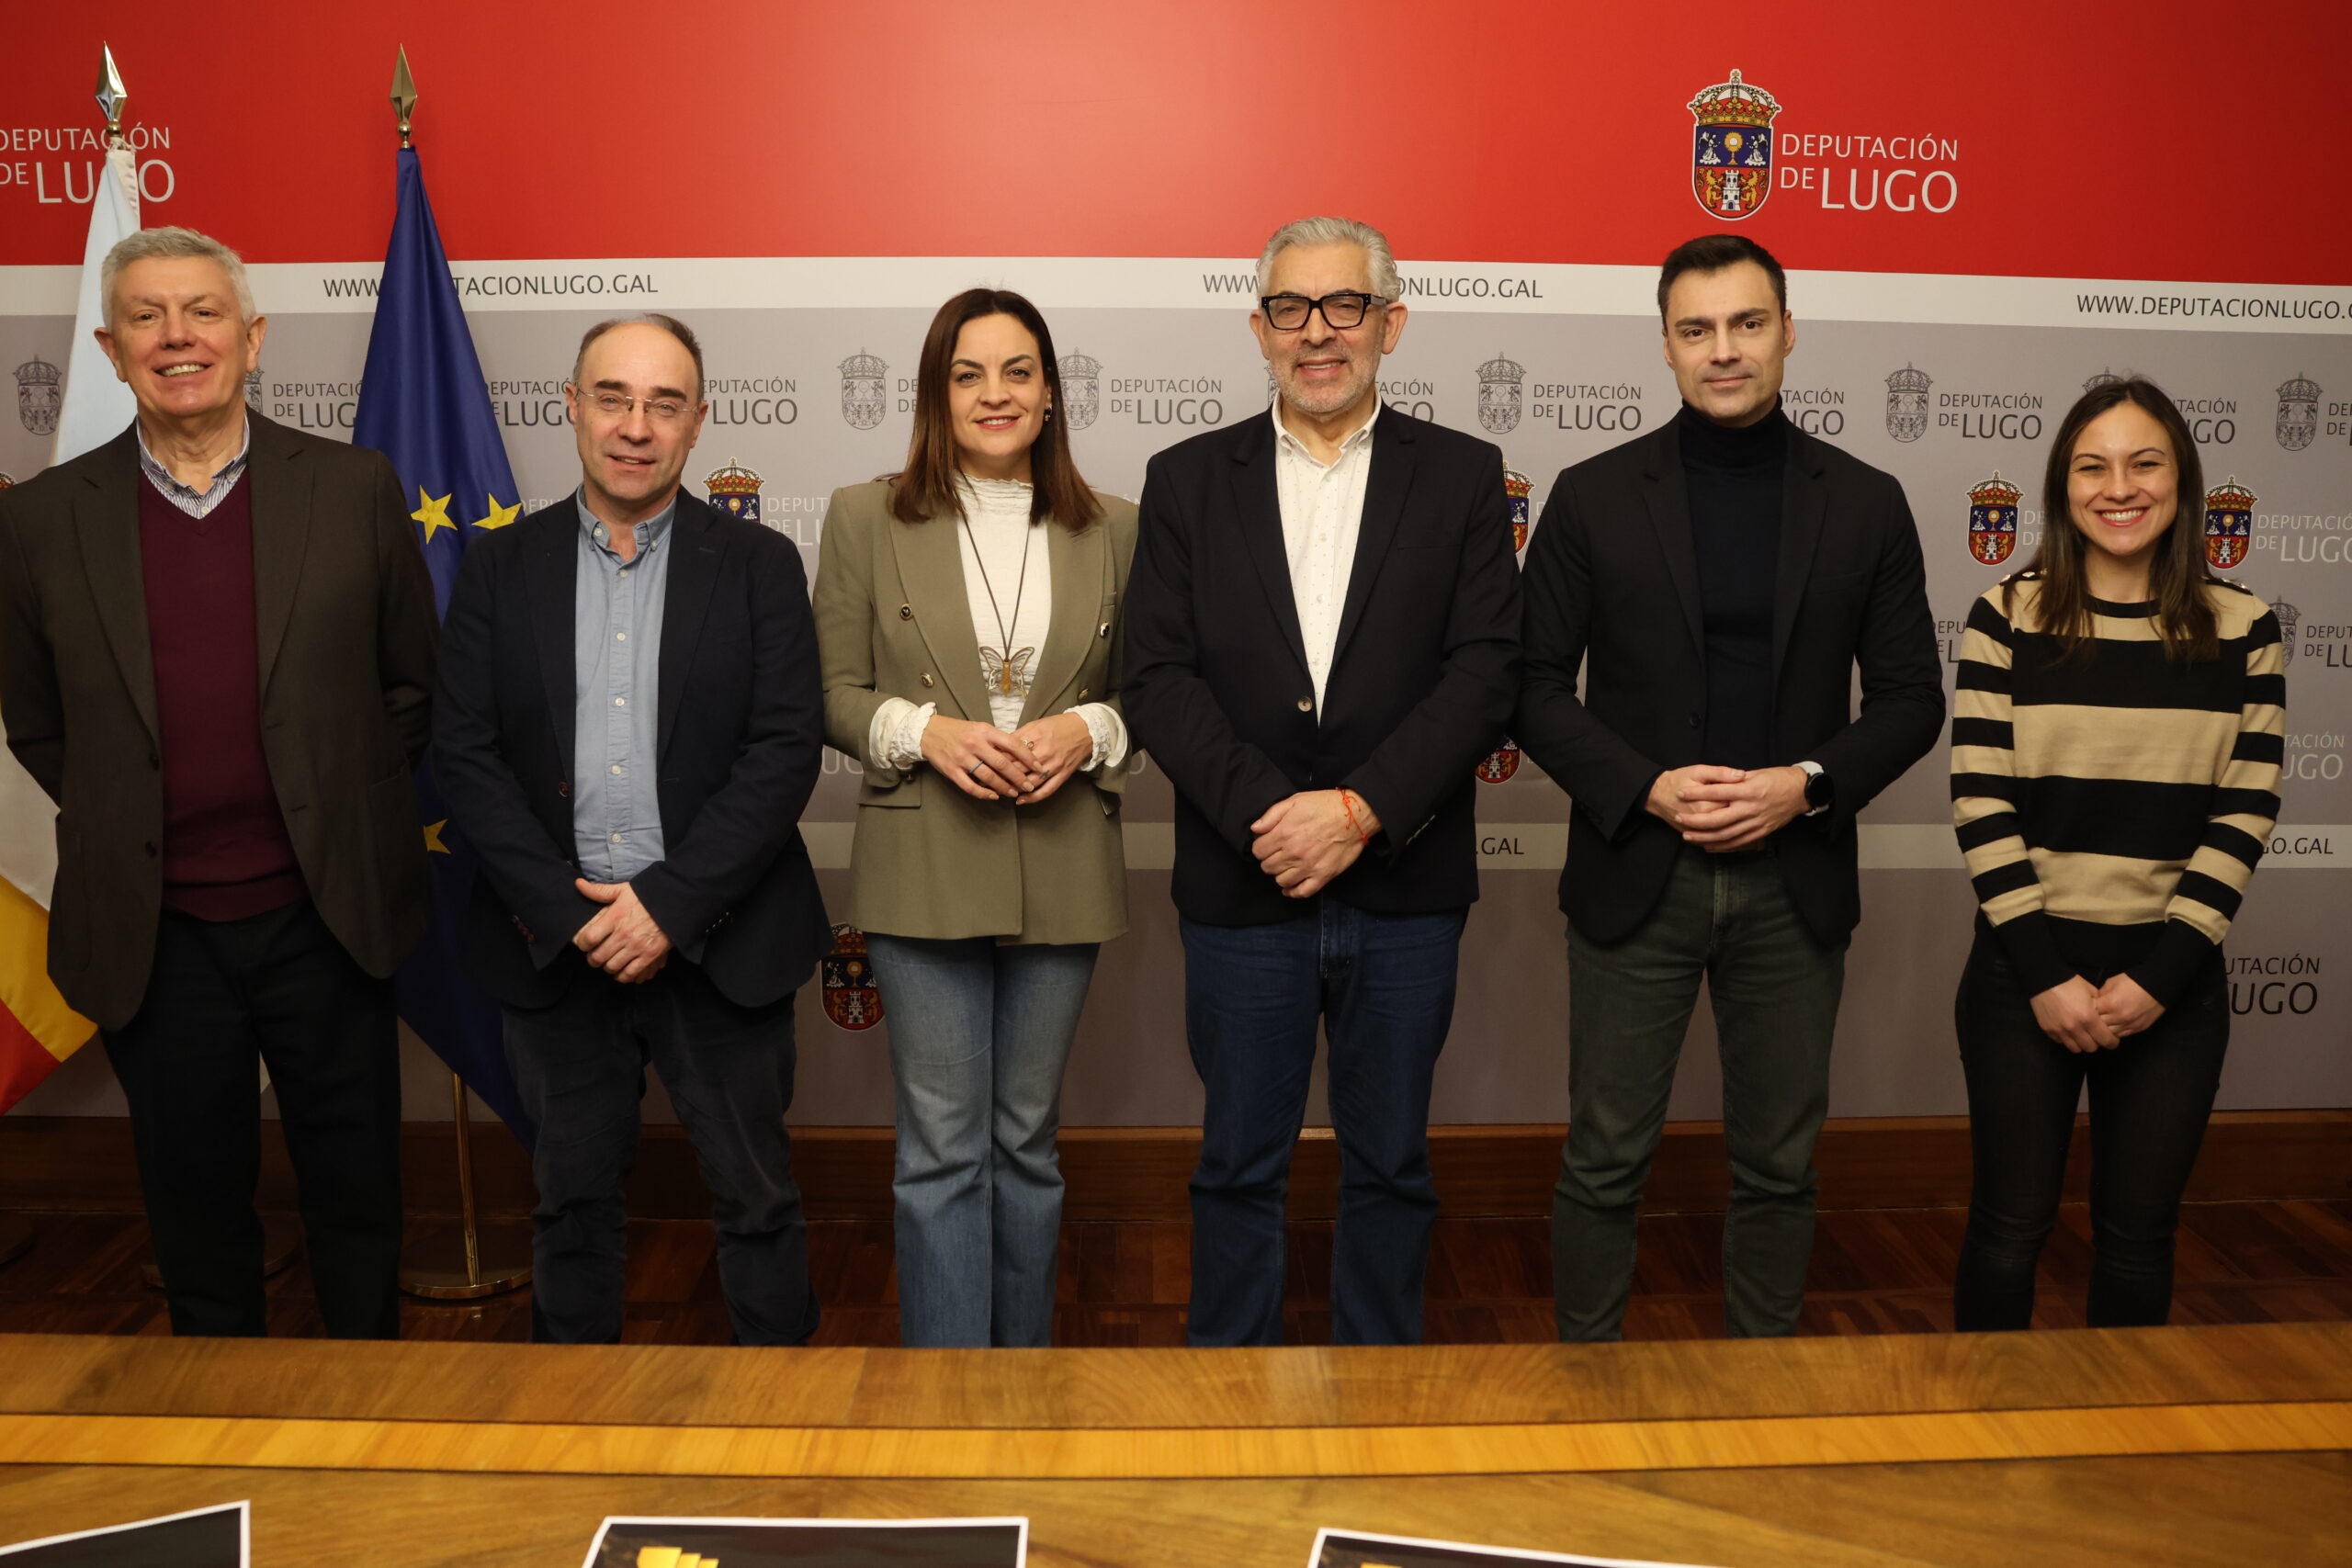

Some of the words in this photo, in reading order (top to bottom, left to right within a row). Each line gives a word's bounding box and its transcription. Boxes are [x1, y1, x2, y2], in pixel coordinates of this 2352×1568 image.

[0, 122, 171, 151] EPUTACÓN
[1781, 133, 1958, 162] DEPUTACIÓN
[36, 159, 175, 204] LUO
[1781, 167, 1815, 189] DE
[1821, 168, 1958, 213] LUGO
[273, 382, 362, 397] DEPUTACI
[704, 376, 796, 393] PUTACIÓN
[1111, 376, 1222, 393] DEPUTACIÓN
[1533, 382, 1642, 400] DEPUTACIÓN
[1782, 388, 1844, 404] TACIÓN
[713, 399, 797, 424] LUGO
[1111, 399, 1132, 412] DE
[1136, 399, 1223, 424] LUGO
[1939, 392, 2042, 410] DEPUTACIÓN
[2172, 398, 2236, 413] TACIÓN
[274, 403, 295, 417] DE
[300, 402, 356, 428] LUG
[504, 400, 574, 426] LUG
[1533, 404, 1555, 418] DE
[1557, 404, 1642, 431] LUGO
[1939, 413, 1959, 427] DE
[1962, 413, 2042, 440] LUGO
[2326, 423, 2346, 435] DE
[767, 497, 829, 513] DEPUT
[2256, 536, 2278, 550] DE
[2304, 644, 2324, 657] DE
[2284, 731, 2345, 749] TACIÓN
[2282, 753, 2343, 780] UGO
[2223, 953, 2320, 976] UTACIÓN
[2231, 982, 2318, 1015] UGO
